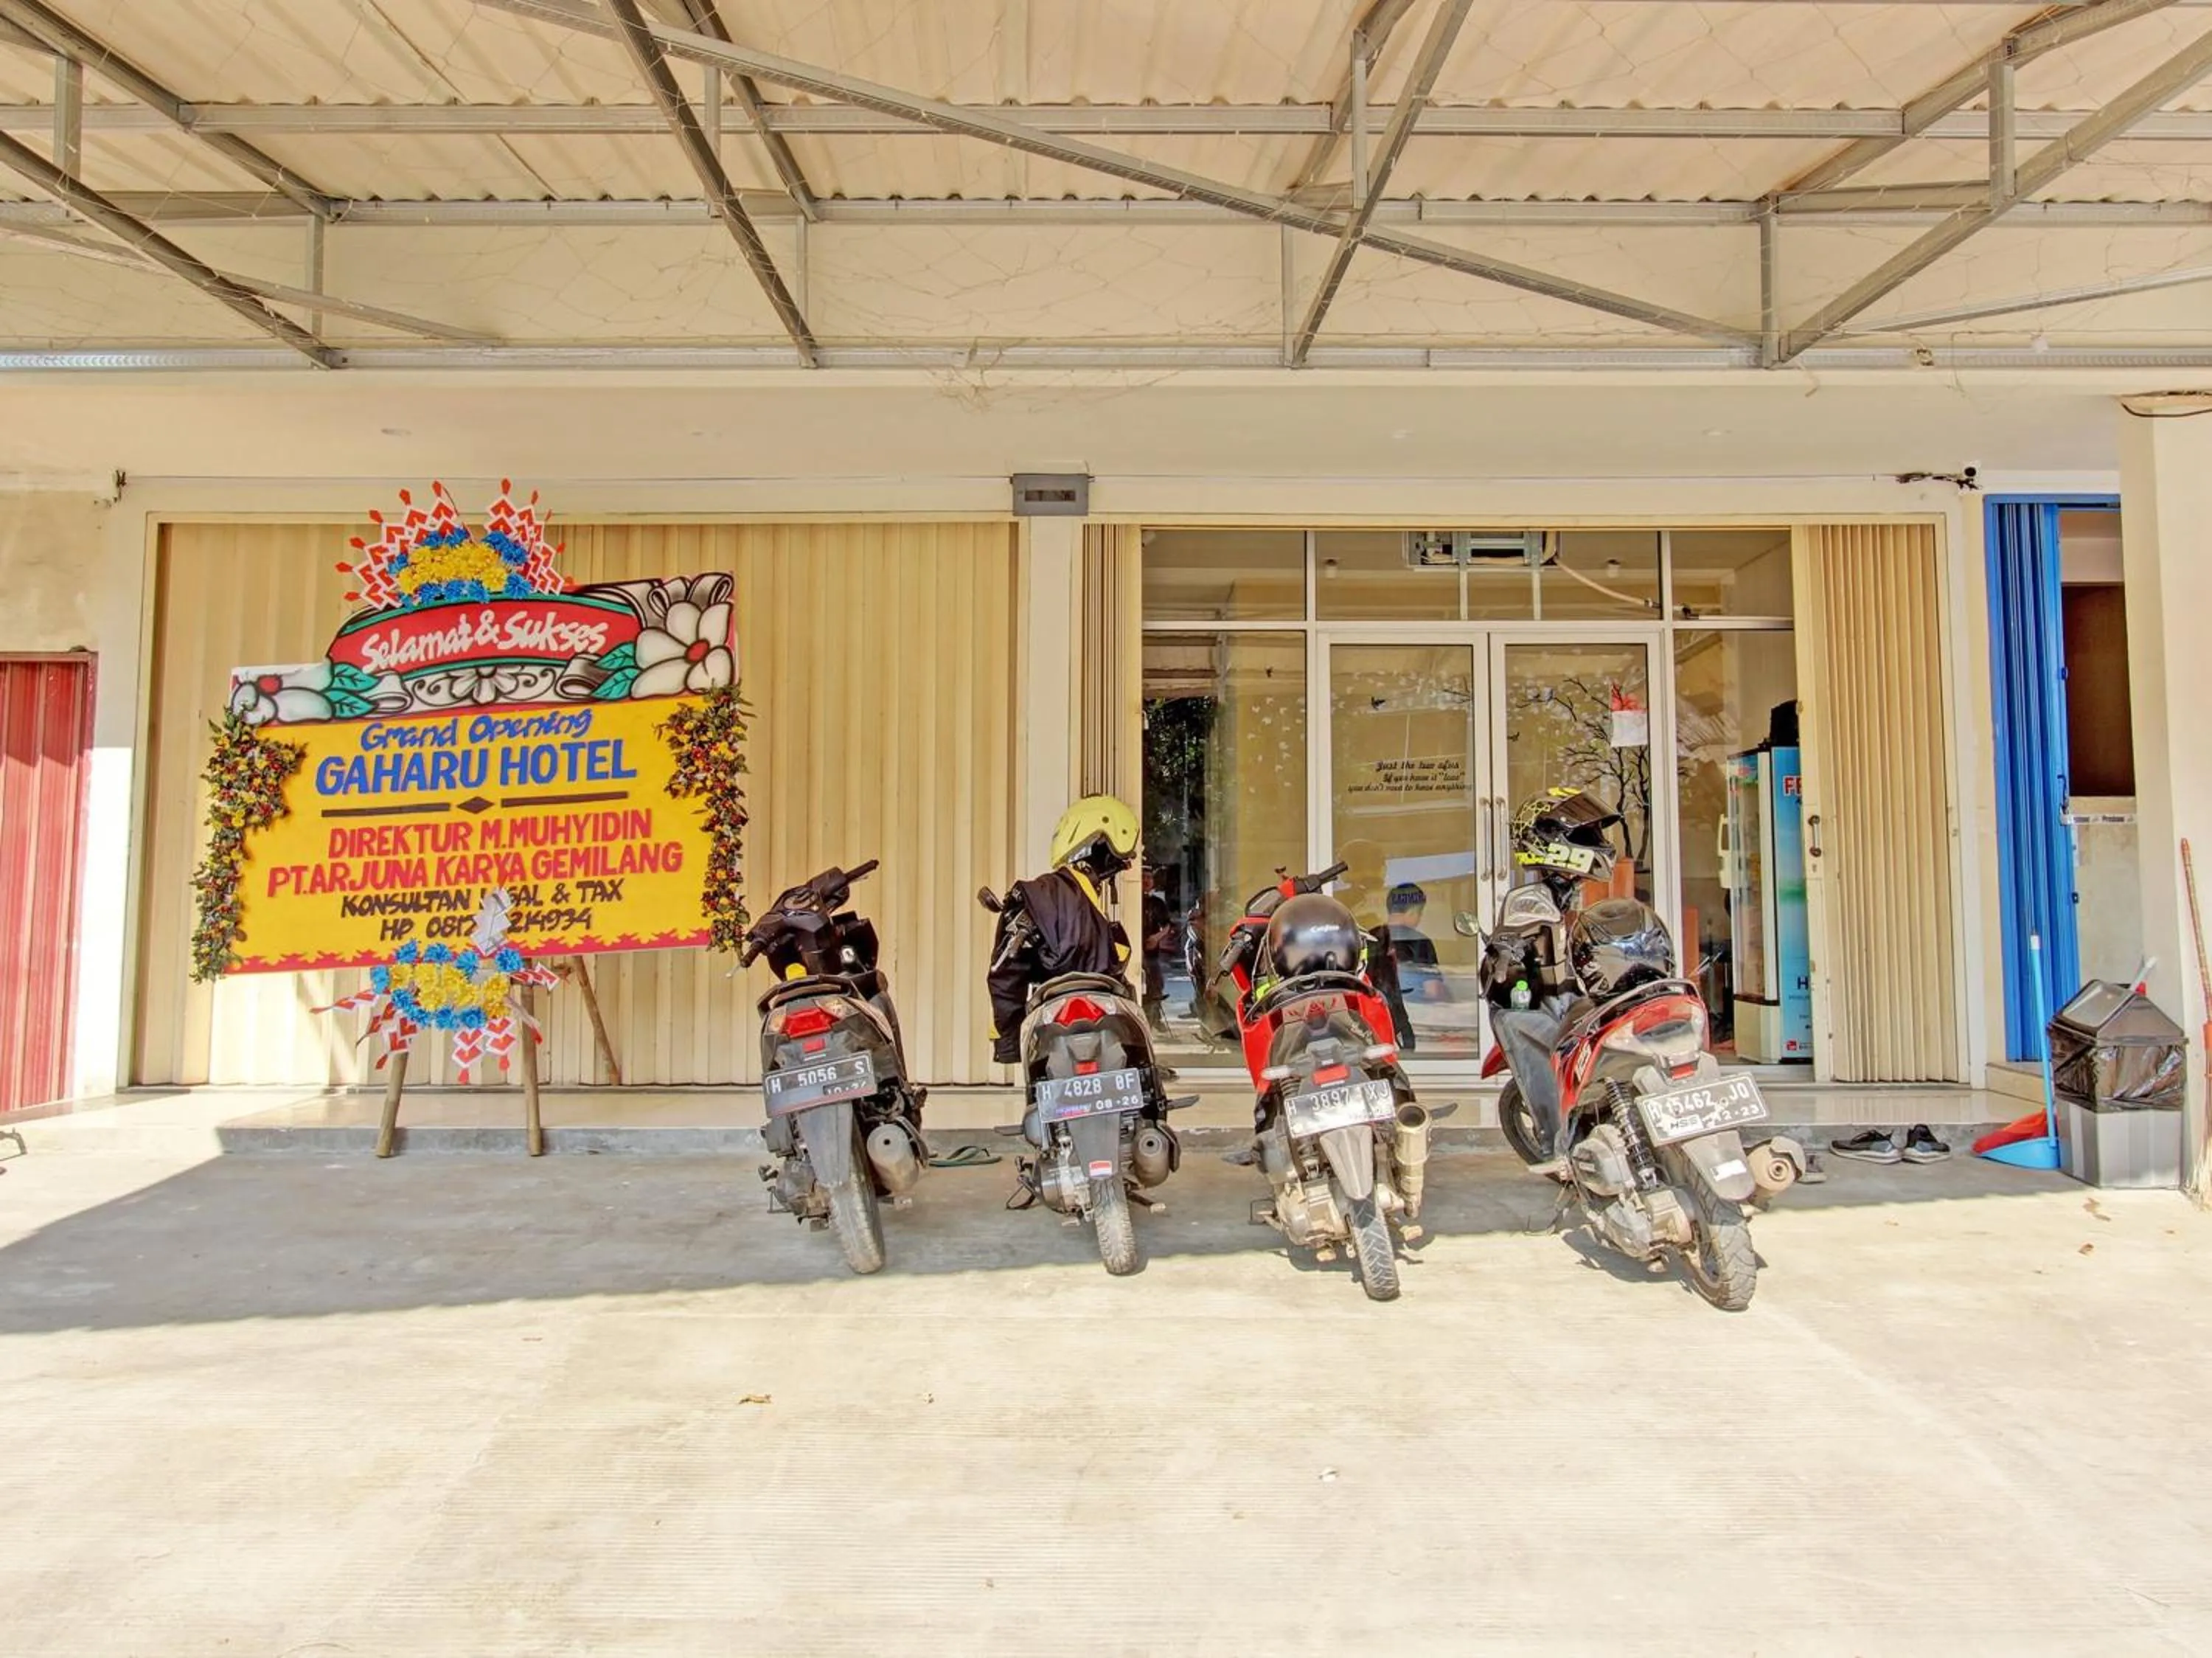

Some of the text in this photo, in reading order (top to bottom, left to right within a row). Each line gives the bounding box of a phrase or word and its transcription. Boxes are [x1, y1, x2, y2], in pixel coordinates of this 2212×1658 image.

[361, 609, 608, 673] Selamat & Sukses
[361, 708, 593, 752] Grand Opening
[316, 739, 637, 796] GAHARU HOTEL
[328, 822, 473, 859] DIREKTUR
[267, 841, 684, 898] PT.ARJUNA KARYA GEMILANG
[341, 878, 625, 918] KONSULTAN LGAL & TAX
[380, 918, 414, 941] HP
[771, 1078, 782, 1094] H
[797, 1066, 837, 1086] 5056
[1042, 1085, 1051, 1100] H
[1065, 1078, 1102, 1096] 4828
[1288, 1099, 1297, 1115] H
[1311, 1088, 1349, 1110] 3897
